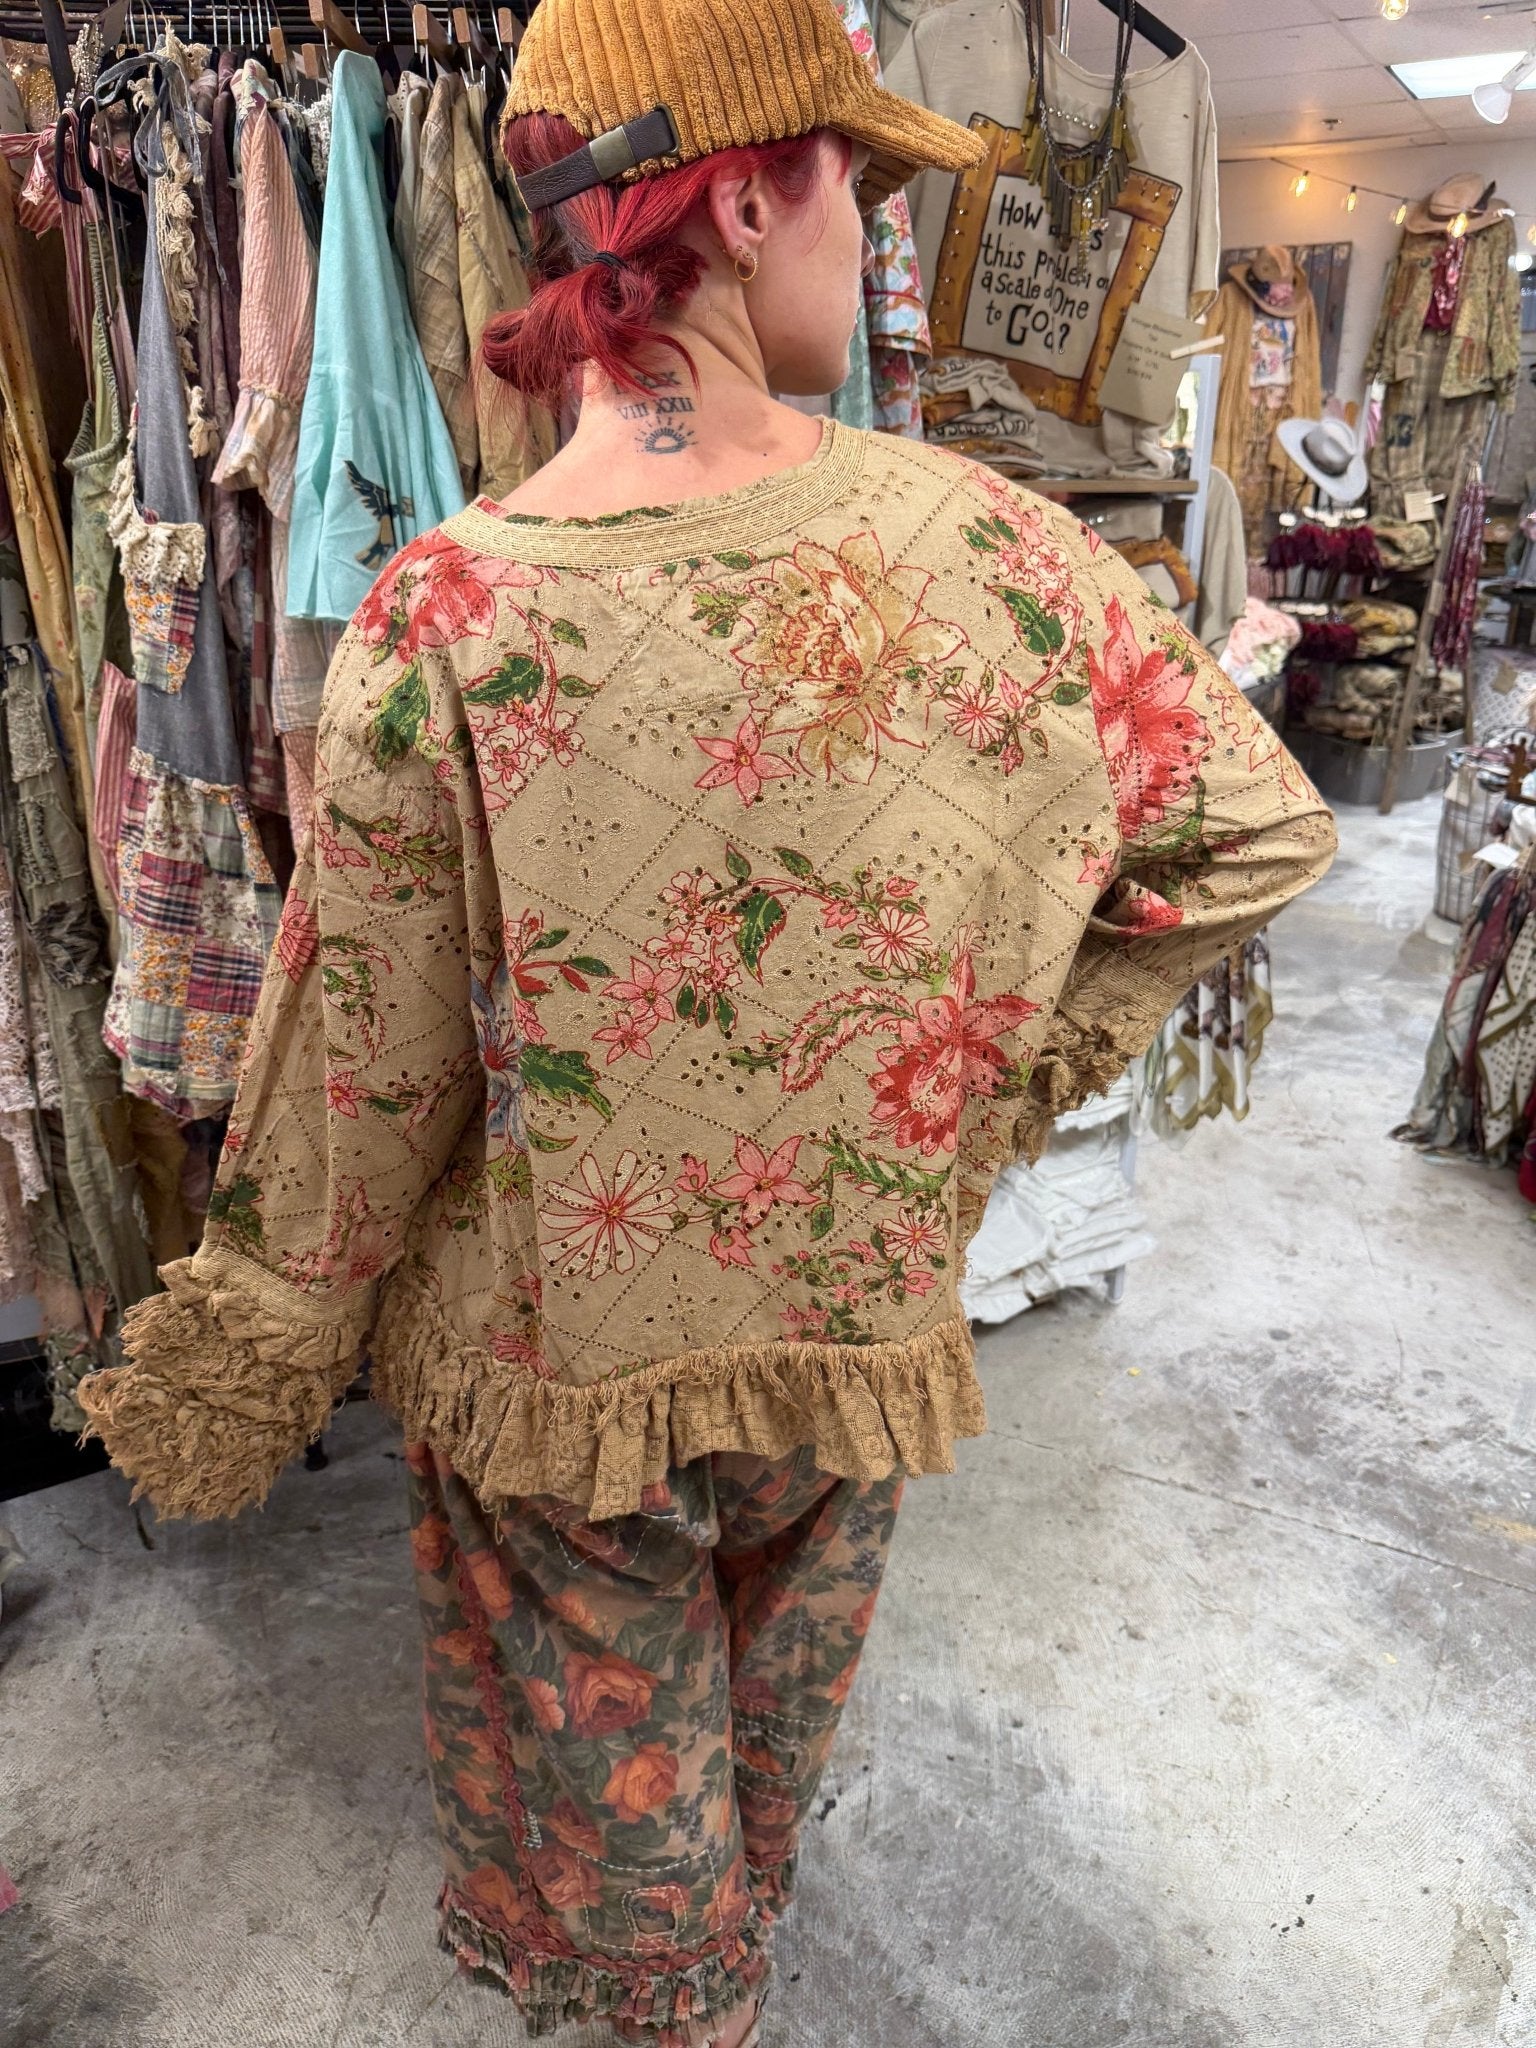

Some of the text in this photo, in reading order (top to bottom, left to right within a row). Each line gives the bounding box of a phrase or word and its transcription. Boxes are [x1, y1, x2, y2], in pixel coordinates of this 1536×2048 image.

[981, 233, 1026, 270] this
[981, 271, 994, 294] a
[986, 300, 1070, 354] to God?
[617, 402, 650, 420] VIII
